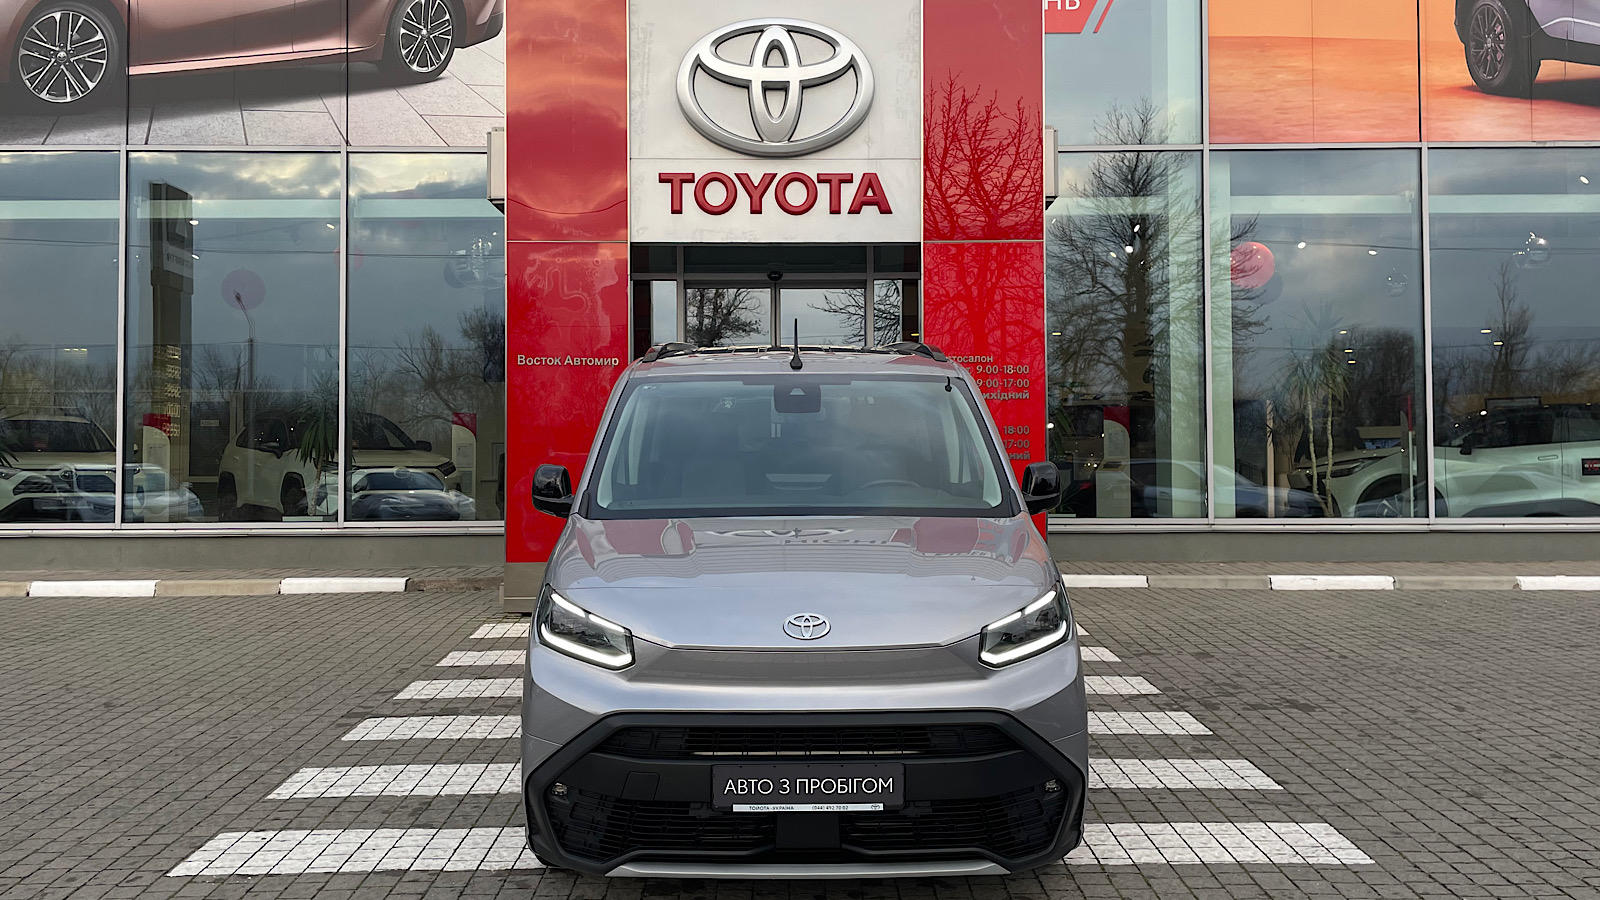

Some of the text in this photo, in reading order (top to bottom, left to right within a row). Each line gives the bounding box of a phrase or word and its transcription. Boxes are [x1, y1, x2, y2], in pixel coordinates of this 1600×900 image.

[658, 171, 893, 216] TOYOTA
[517, 354, 620, 368] Восток Автомир
[946, 355, 994, 363] тосалон
[981, 390, 1030, 401] ихідний
[723, 779, 774, 795] АВТО
[796, 777, 894, 794] ПРОБІГОМ
